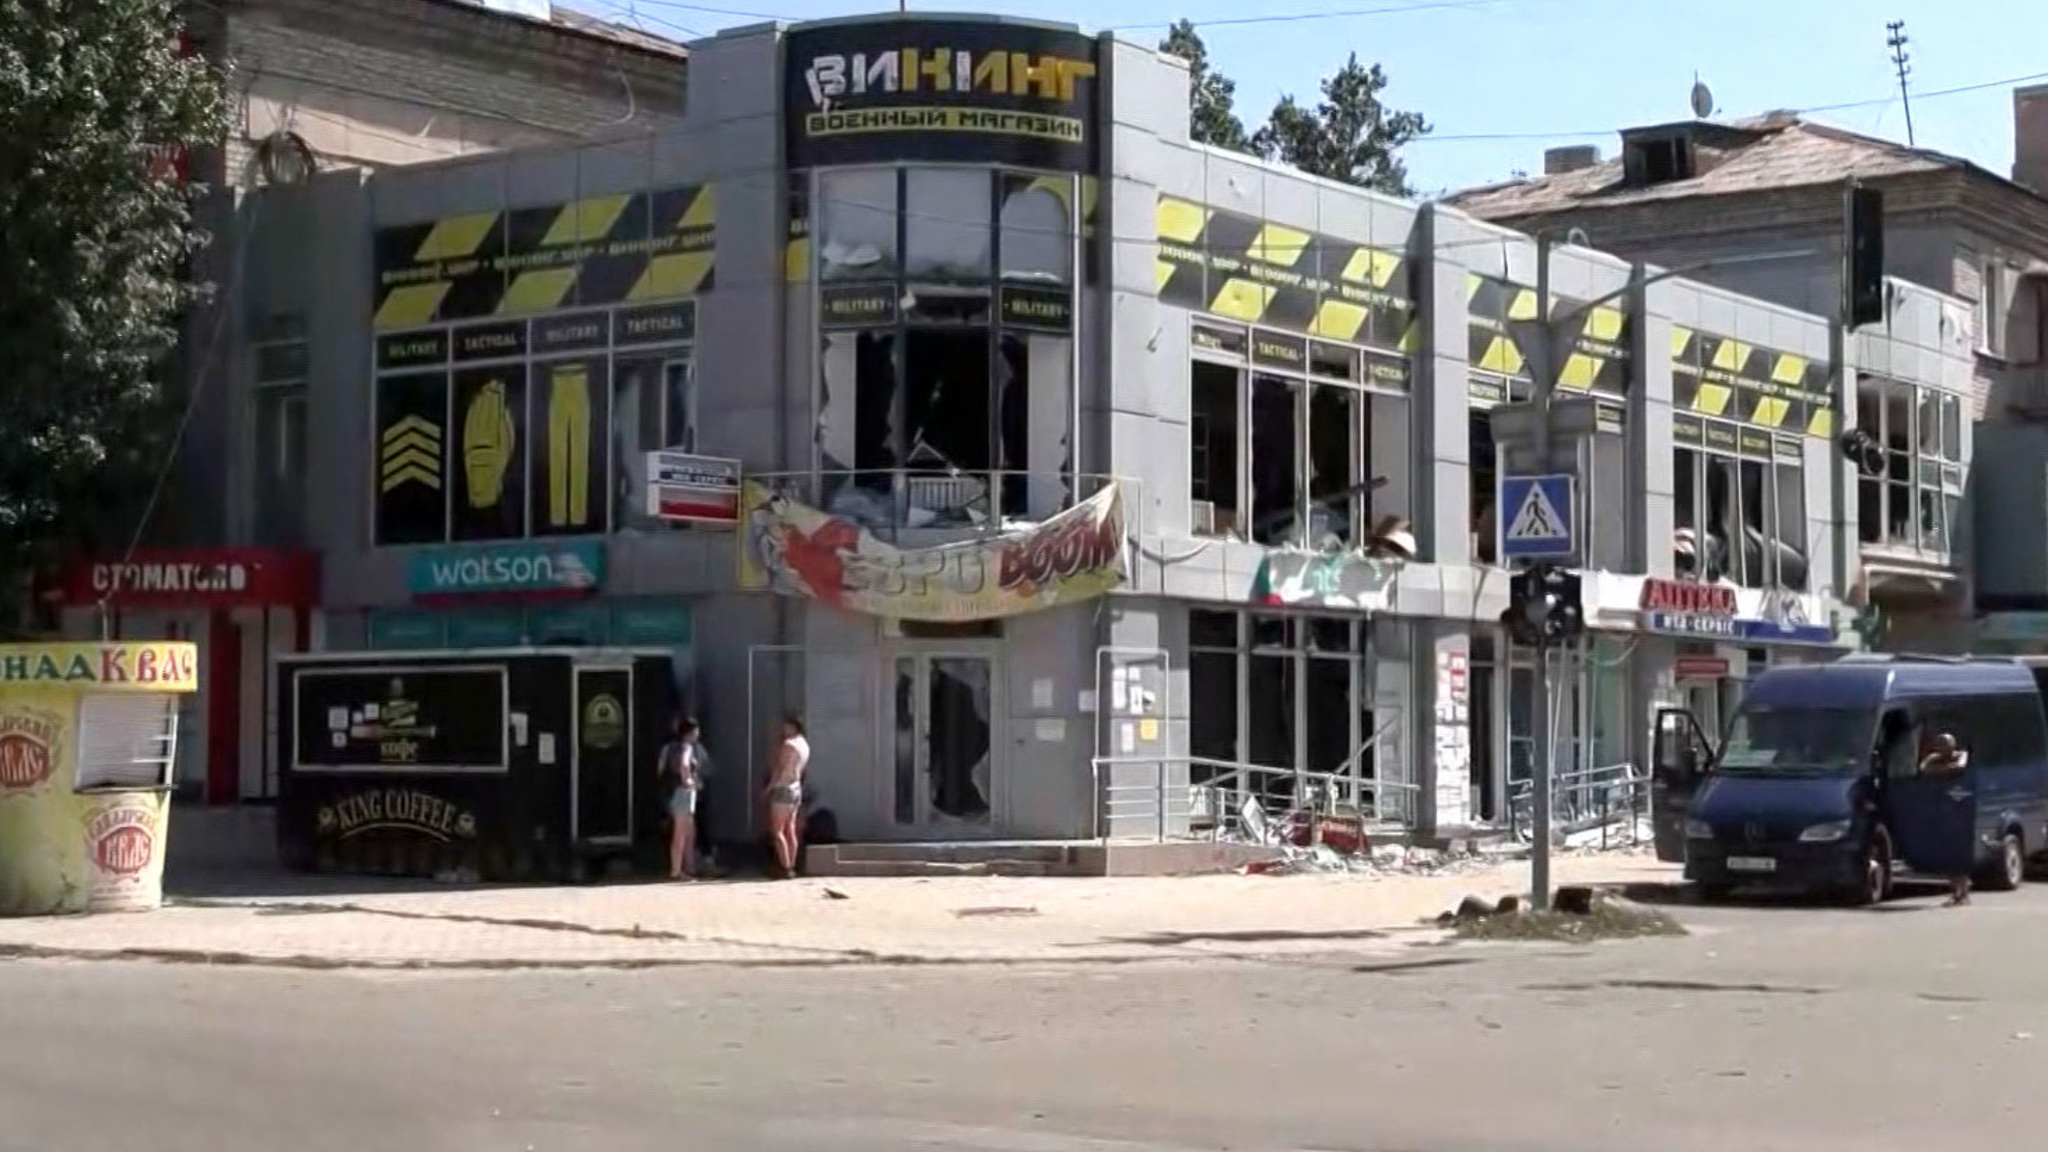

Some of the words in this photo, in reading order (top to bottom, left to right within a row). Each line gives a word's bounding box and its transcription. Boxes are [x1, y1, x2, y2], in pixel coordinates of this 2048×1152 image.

[806, 46, 1096, 100] ВИКИНГ
[808, 109, 947, 132] ВОЕННЫЙ
[958, 111, 1082, 138] МАГАЗИН
[831, 298, 886, 314] MILITARY
[1010, 299, 1064, 317] MILITARY
[627, 315, 686, 334] TACTICAL
[1257, 341, 1300, 363] TACTICAL
[1650, 580, 1738, 615] АПТЕКА
[101, 648, 192, 682] КВАС
[337, 790, 381, 829] KING
[385, 790, 457, 833] COFFEE
